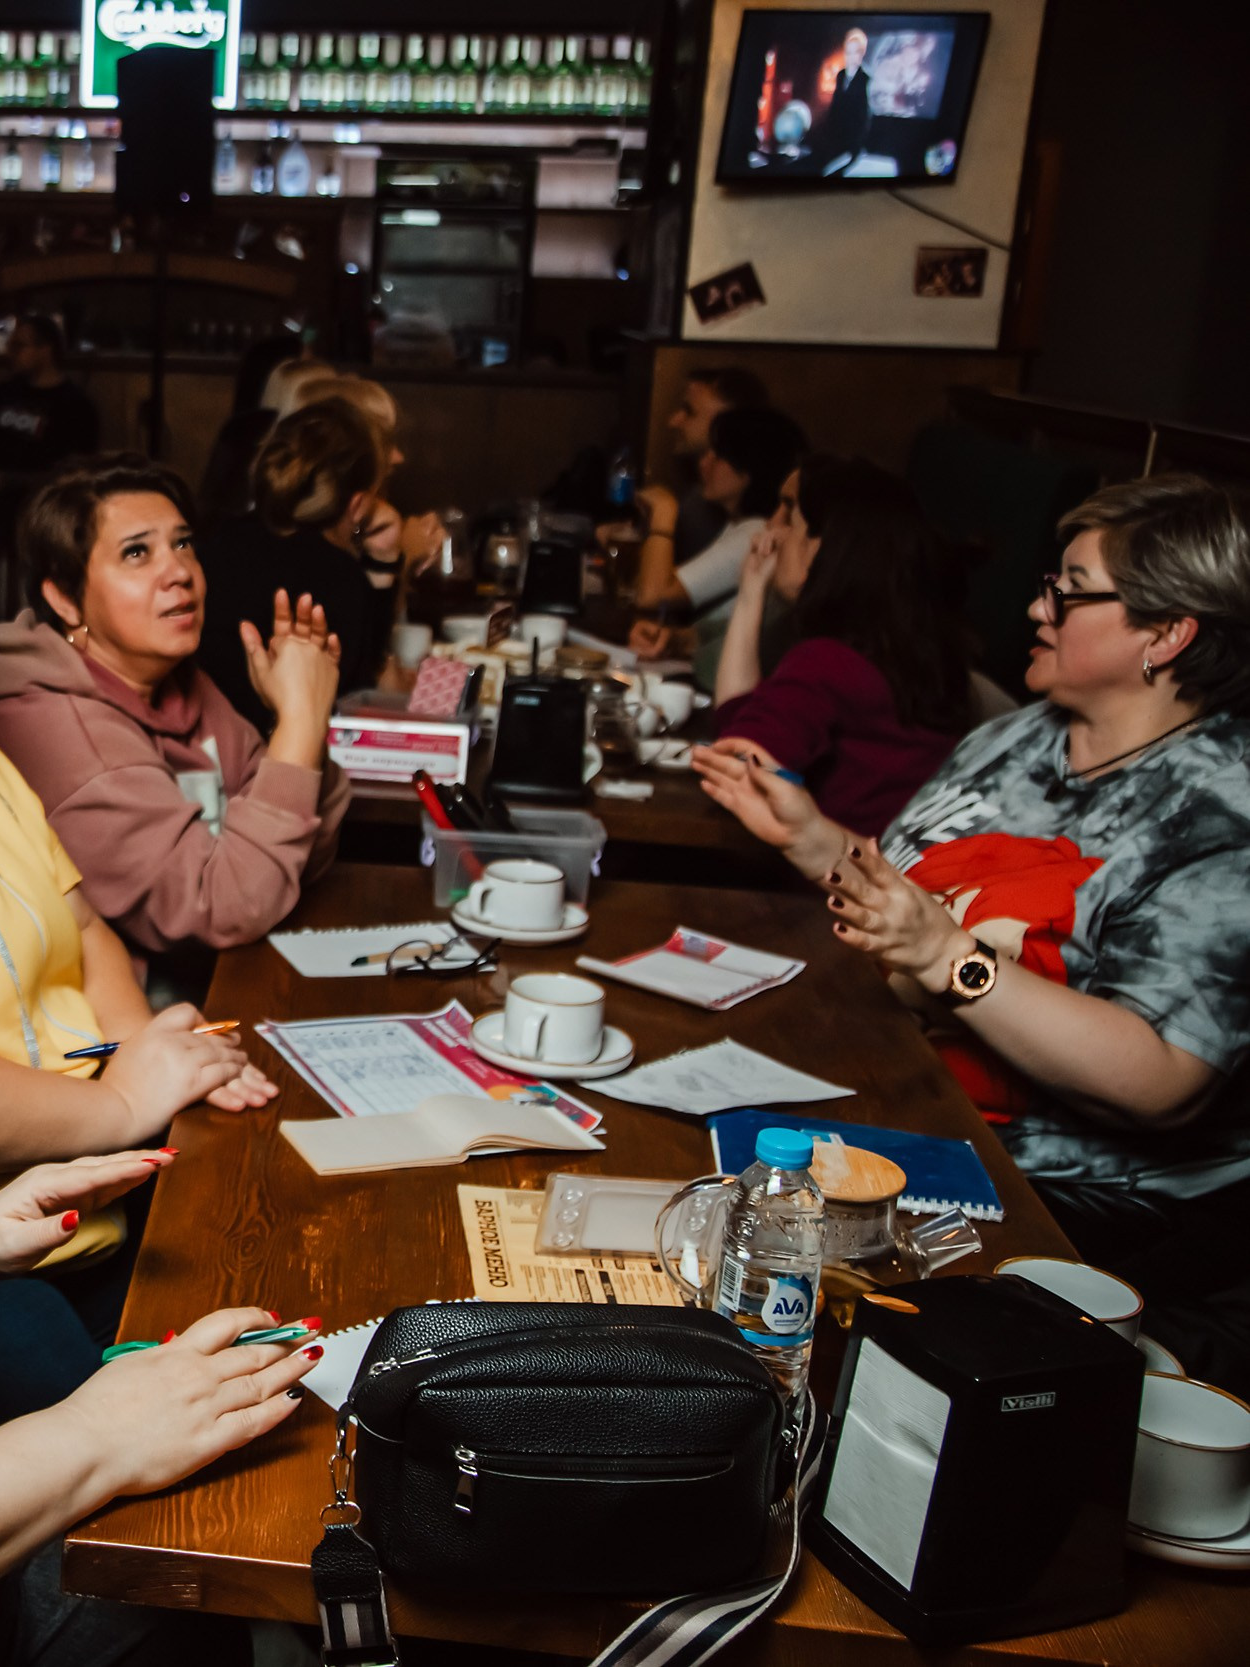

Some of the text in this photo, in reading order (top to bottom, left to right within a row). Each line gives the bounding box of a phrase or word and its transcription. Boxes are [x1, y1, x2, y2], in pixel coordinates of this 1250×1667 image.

[97, 0, 227, 46] Carlsberg
[475, 1199, 509, 1288] БАРНОЕ МЕНЮ
